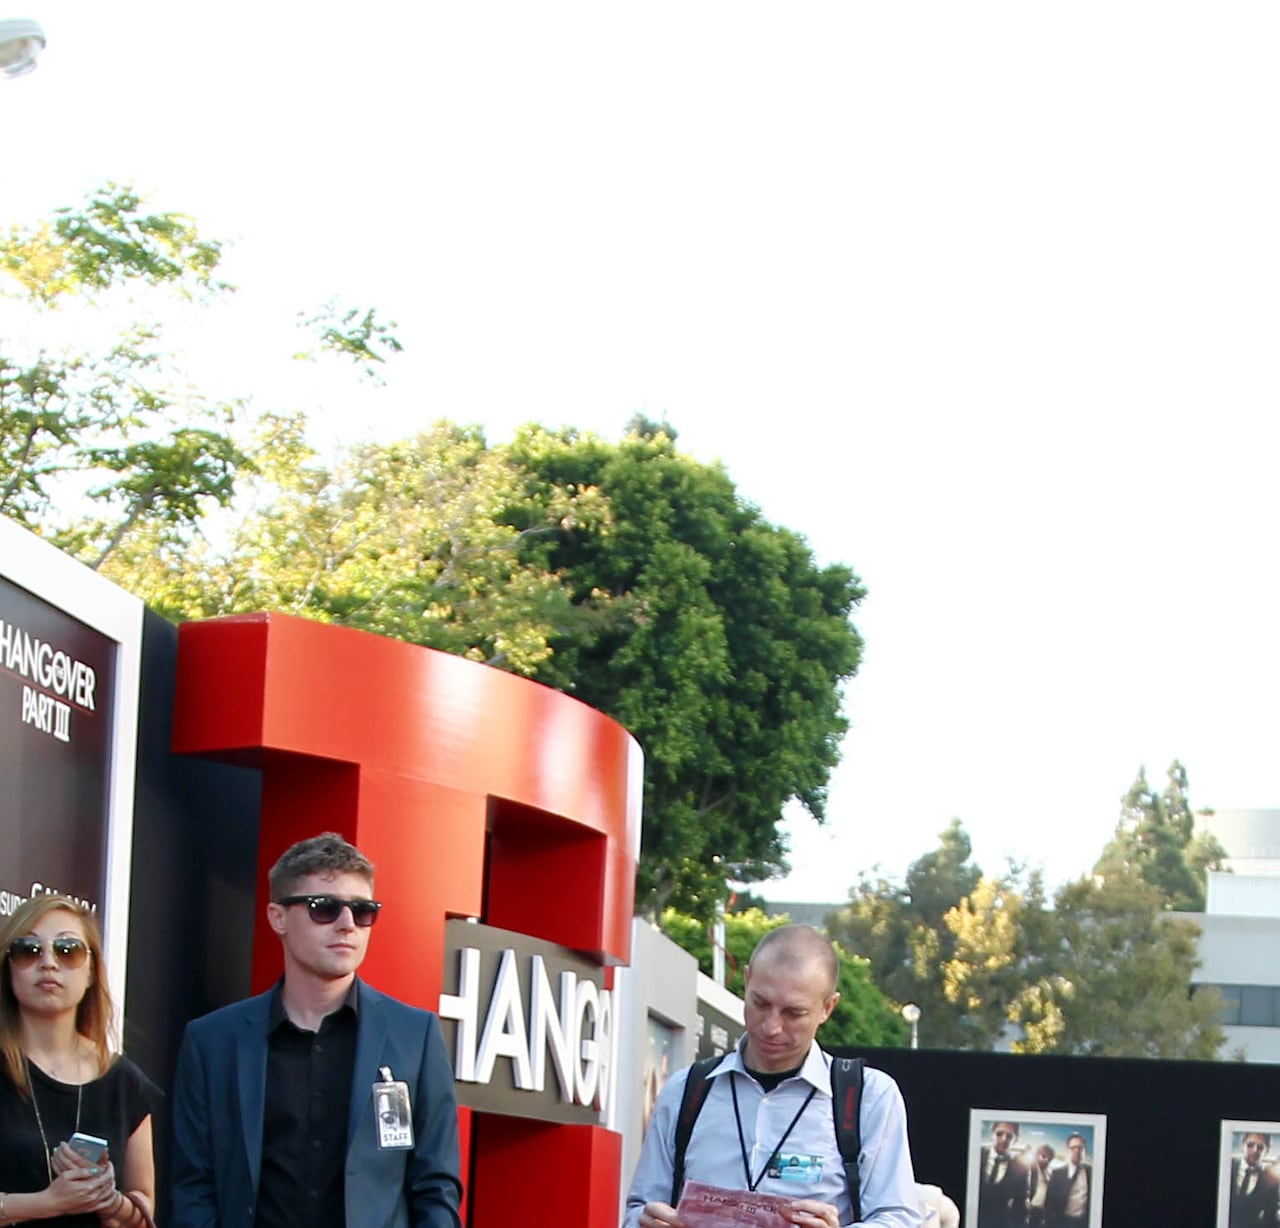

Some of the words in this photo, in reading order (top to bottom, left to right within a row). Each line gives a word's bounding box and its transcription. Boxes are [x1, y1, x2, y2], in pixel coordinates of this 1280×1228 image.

[23, 686, 55, 733] PART
[53, 702, 71, 742] III
[384, 1132, 408, 1142] STAFF
